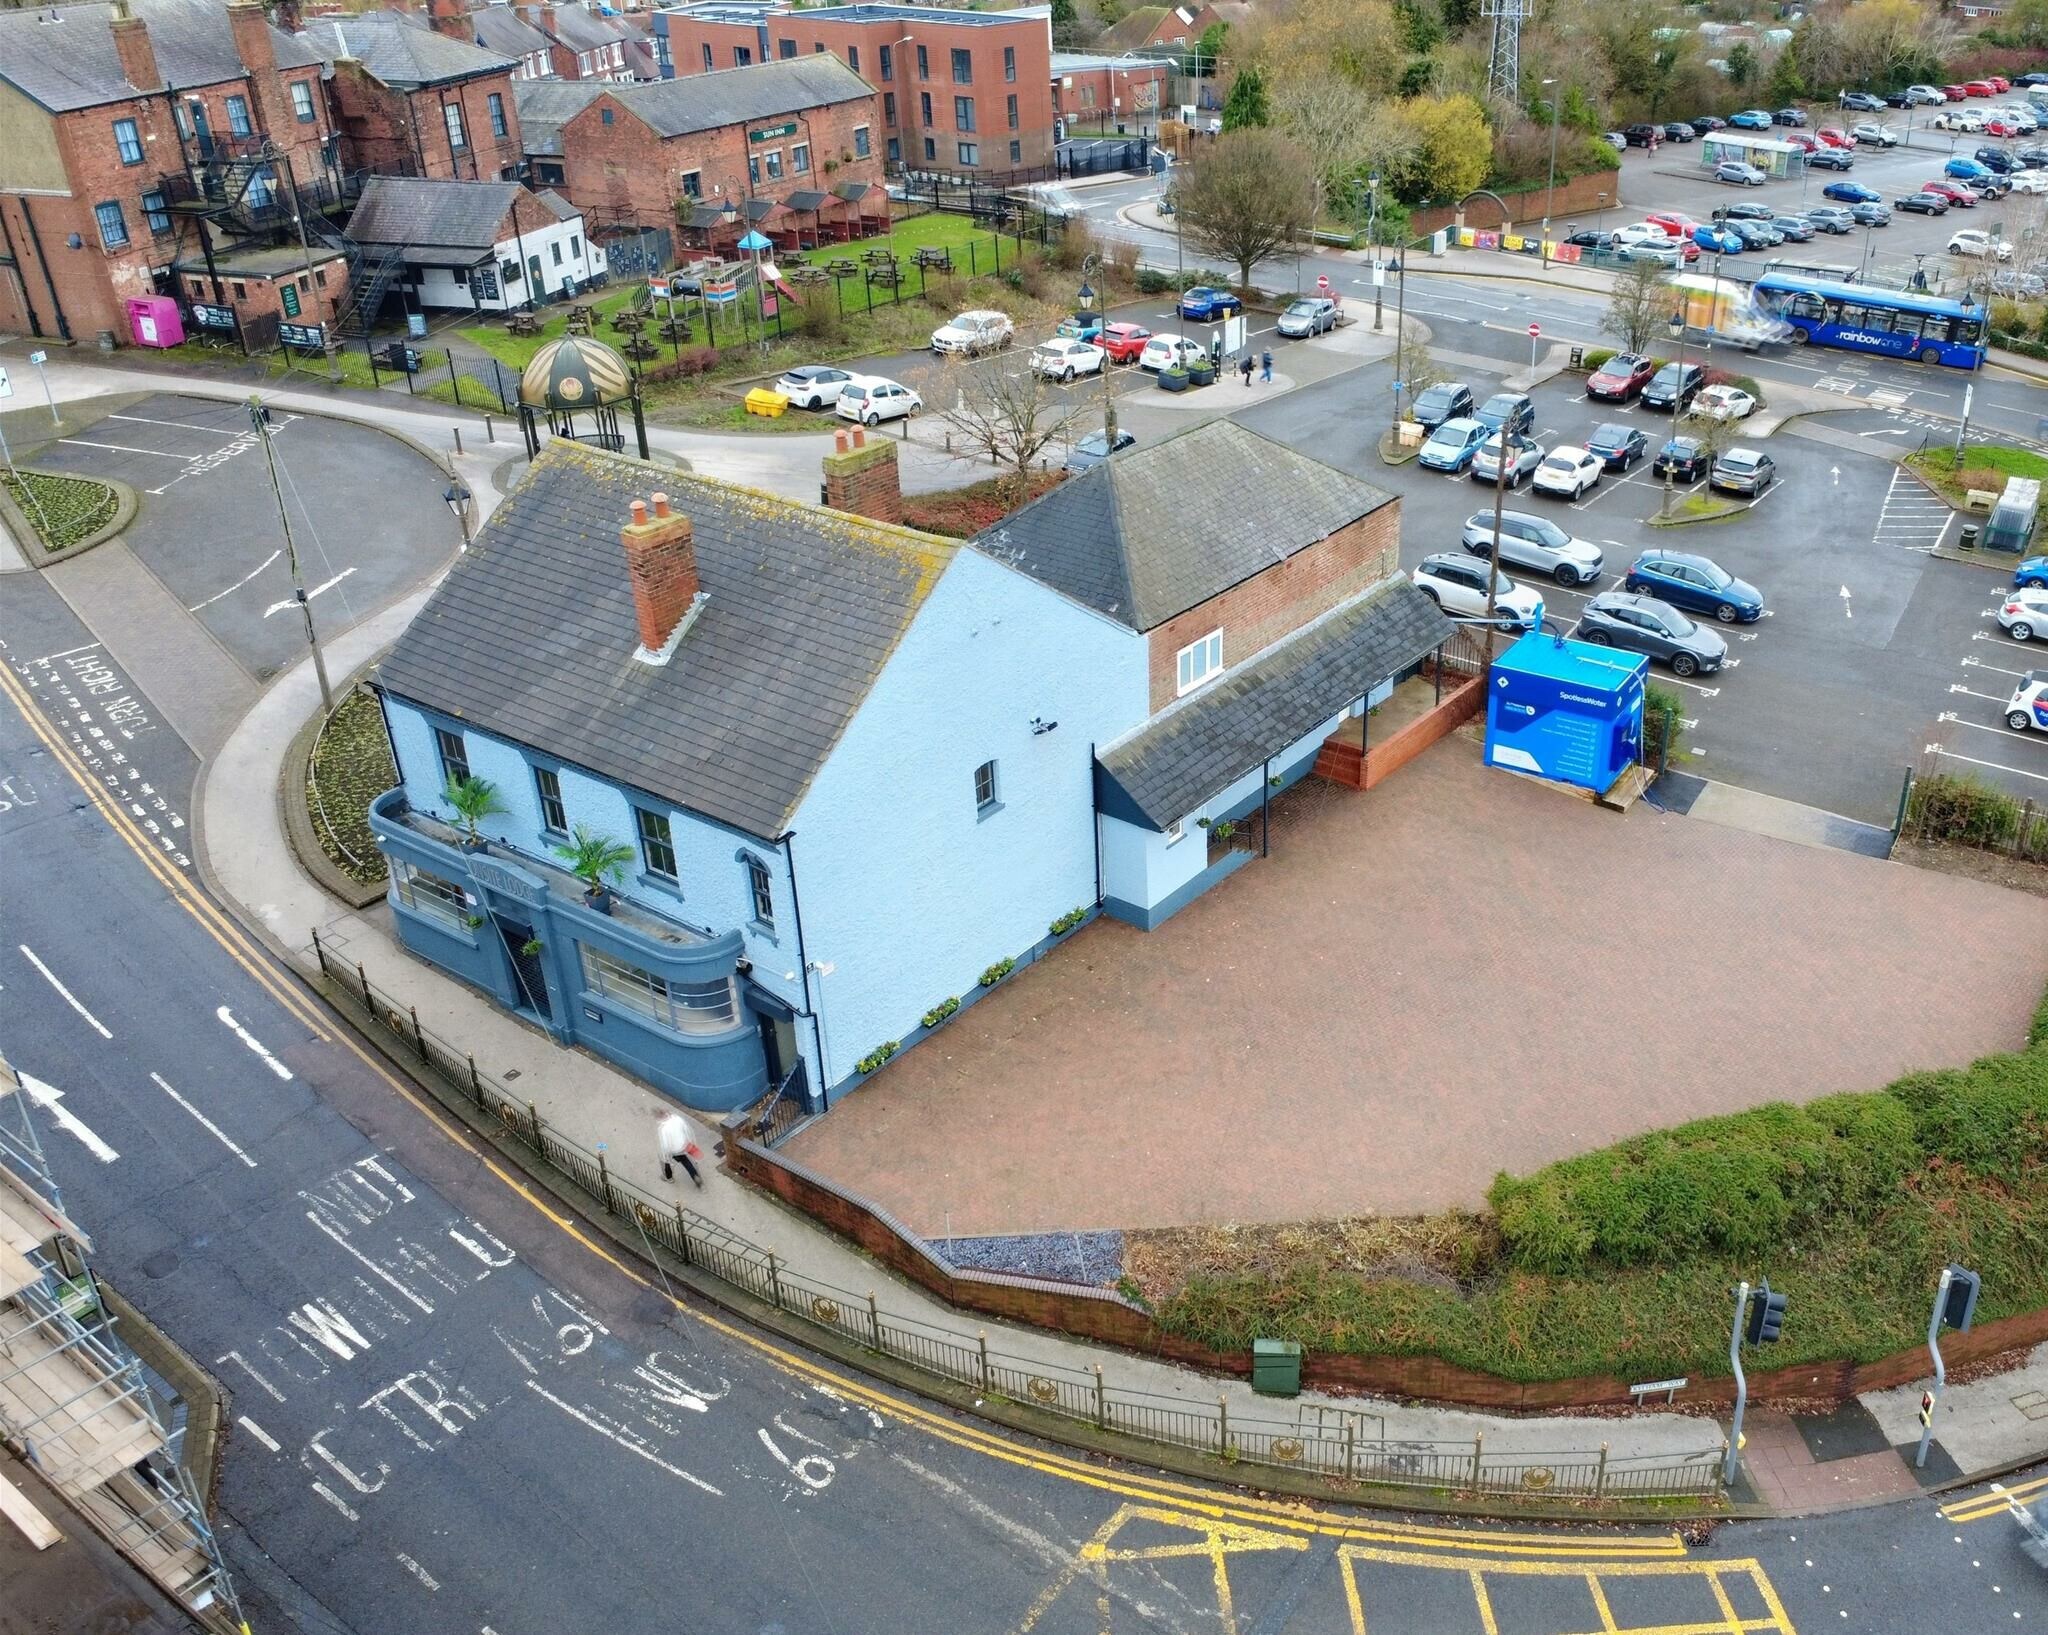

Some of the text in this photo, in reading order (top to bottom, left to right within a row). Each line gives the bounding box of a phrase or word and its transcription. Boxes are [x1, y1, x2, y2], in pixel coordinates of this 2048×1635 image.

[1839, 331, 1880, 345] rainbow
[181, 424, 286, 476] RESERVD
[1559, 692, 1606, 707] SpotlessWater
